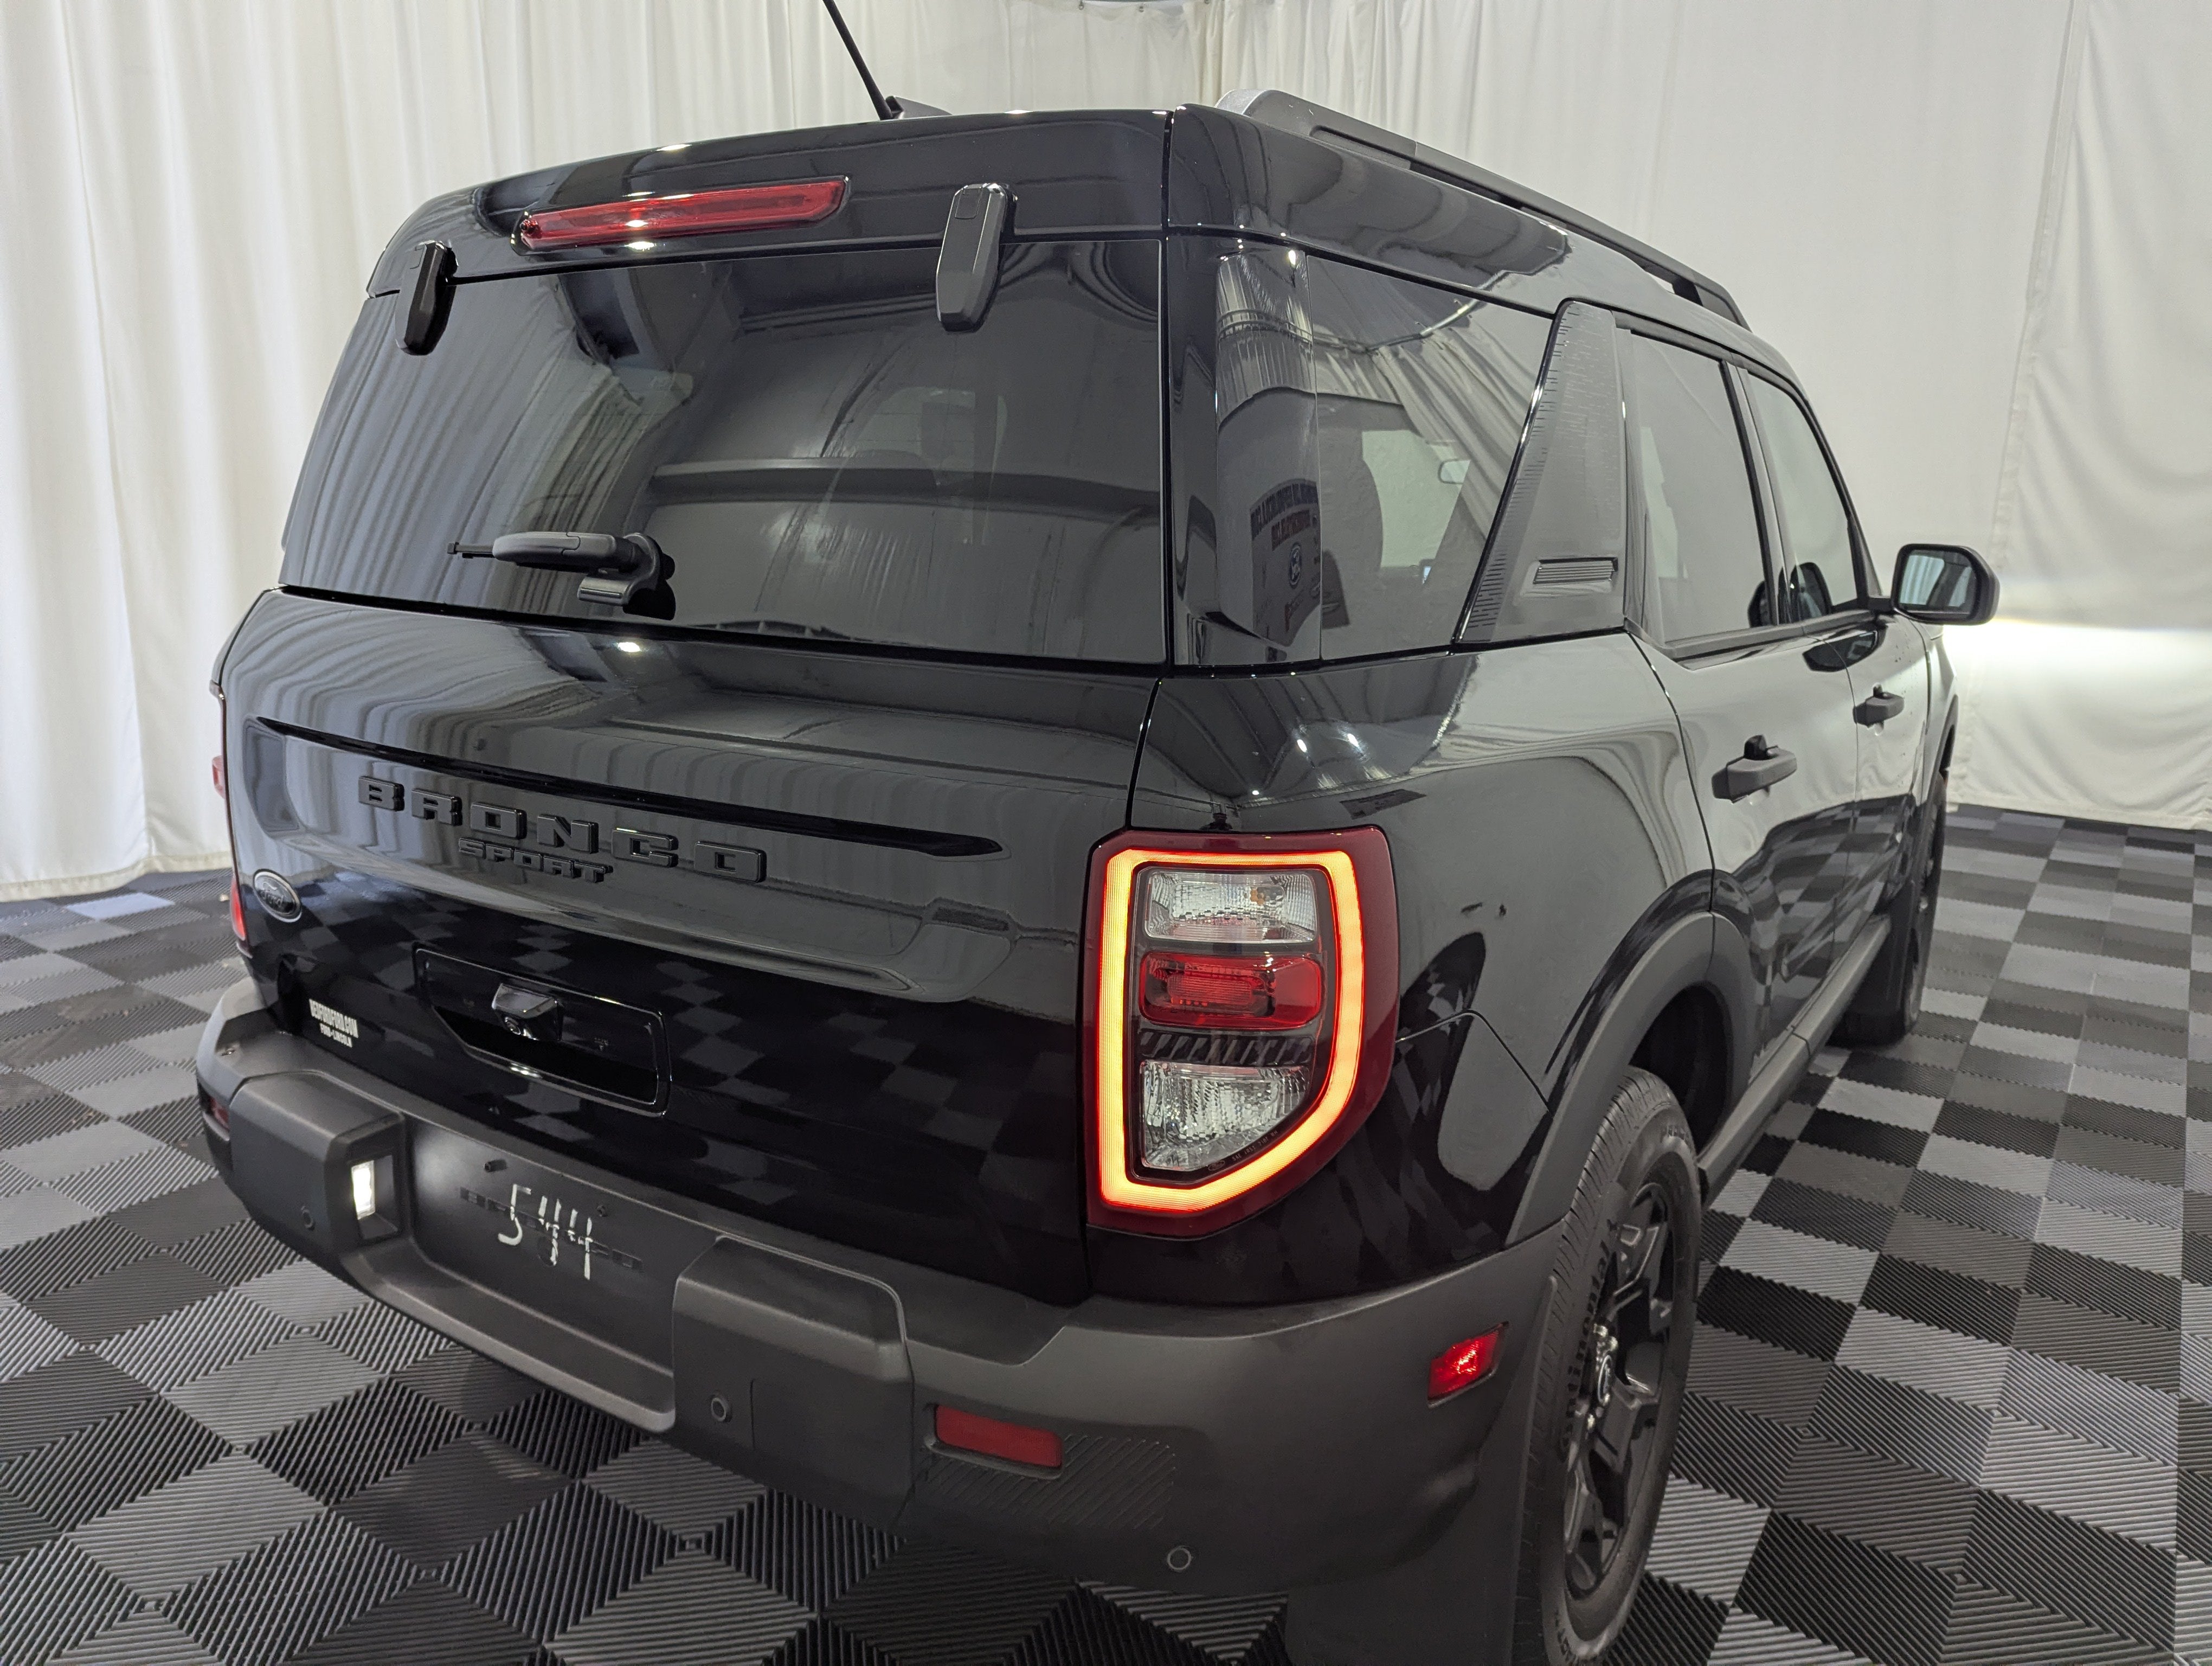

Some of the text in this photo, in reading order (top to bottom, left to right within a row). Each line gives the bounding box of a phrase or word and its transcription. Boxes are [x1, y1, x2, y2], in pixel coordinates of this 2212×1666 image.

[358, 775, 767, 883] BRONCO
[458, 837, 614, 883] SPORT
[498, 1183, 593, 1280] 544
